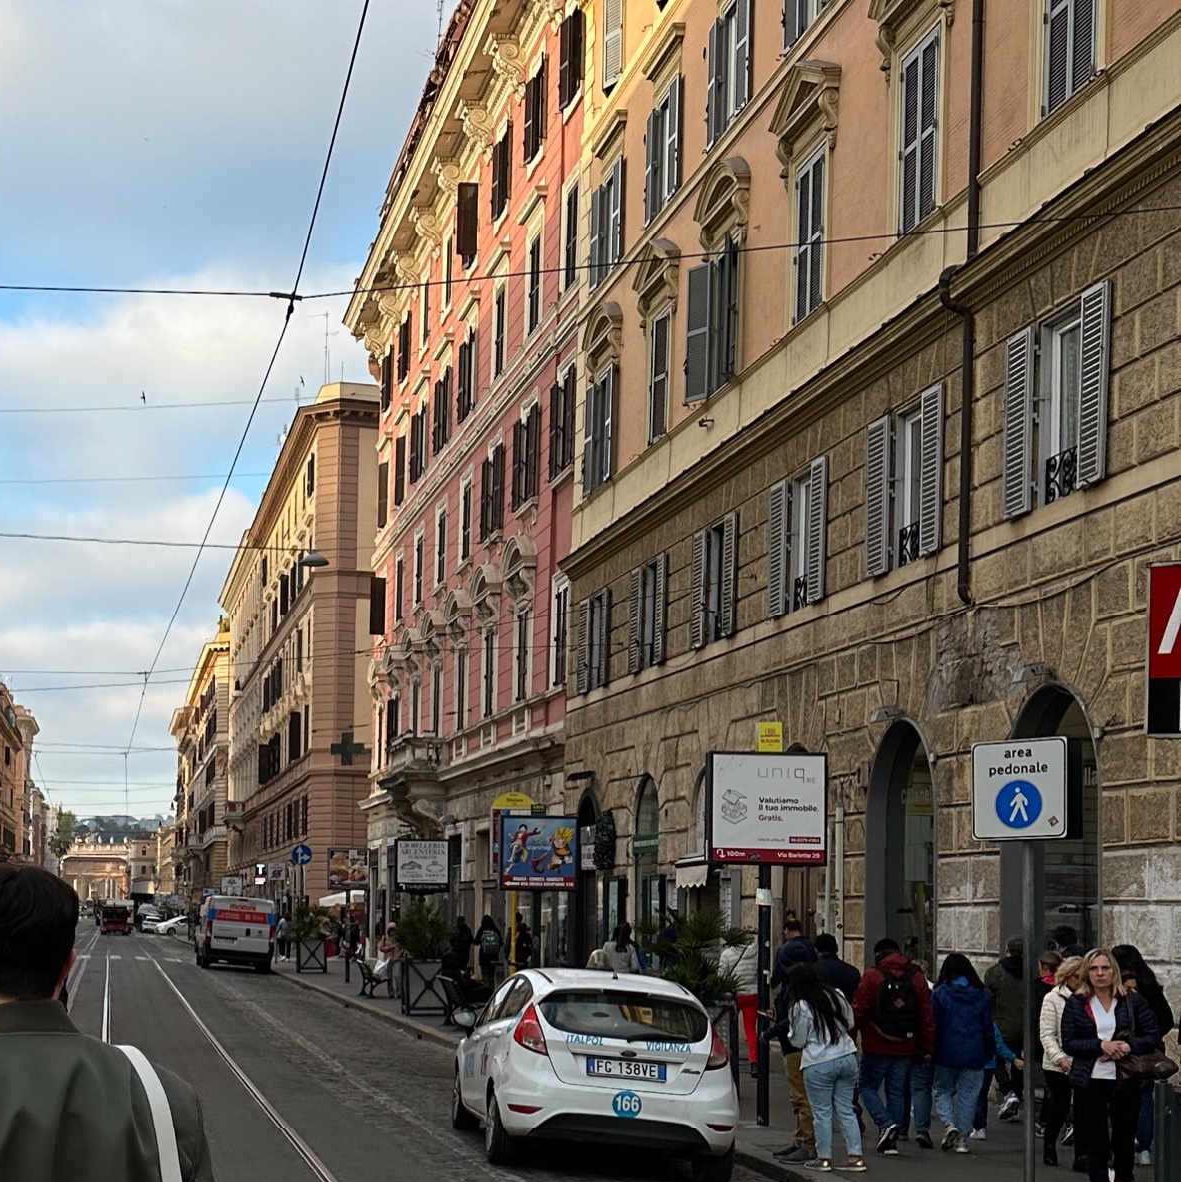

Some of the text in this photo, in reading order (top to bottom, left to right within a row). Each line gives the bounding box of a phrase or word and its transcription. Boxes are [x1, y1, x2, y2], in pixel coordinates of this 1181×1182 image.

[1004, 748, 1033, 759] area
[988, 761, 1049, 778] pedonale
[758, 797, 799, 805] Valutiamo
[566, 1034, 692, 1054] ITALPOL VIGILANZA
[596, 1060, 657, 1078] FG 138VE
[615, 1095, 640, 1112] 166
